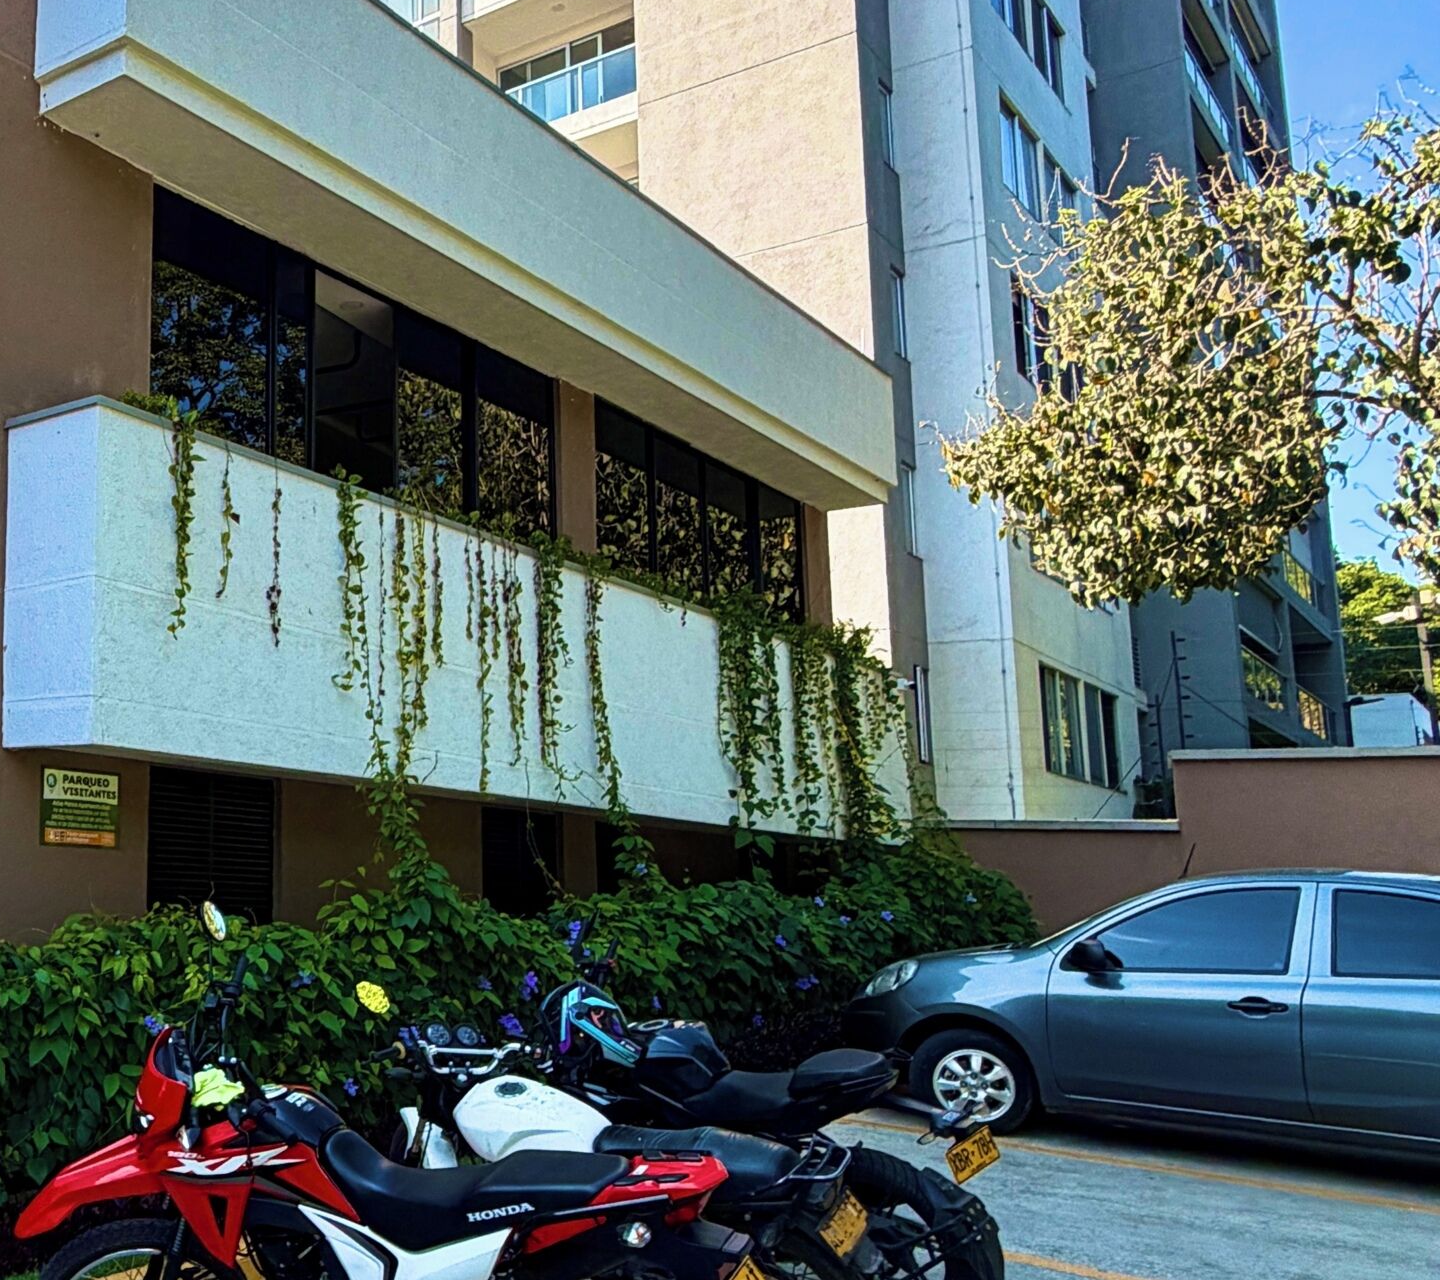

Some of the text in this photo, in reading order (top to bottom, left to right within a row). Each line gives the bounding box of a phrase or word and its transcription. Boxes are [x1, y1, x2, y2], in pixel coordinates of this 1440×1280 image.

[62, 774, 110, 788] PARQUEO
[62, 786, 117, 800] VISITANTES
[466, 1202, 535, 1222] HONDA
